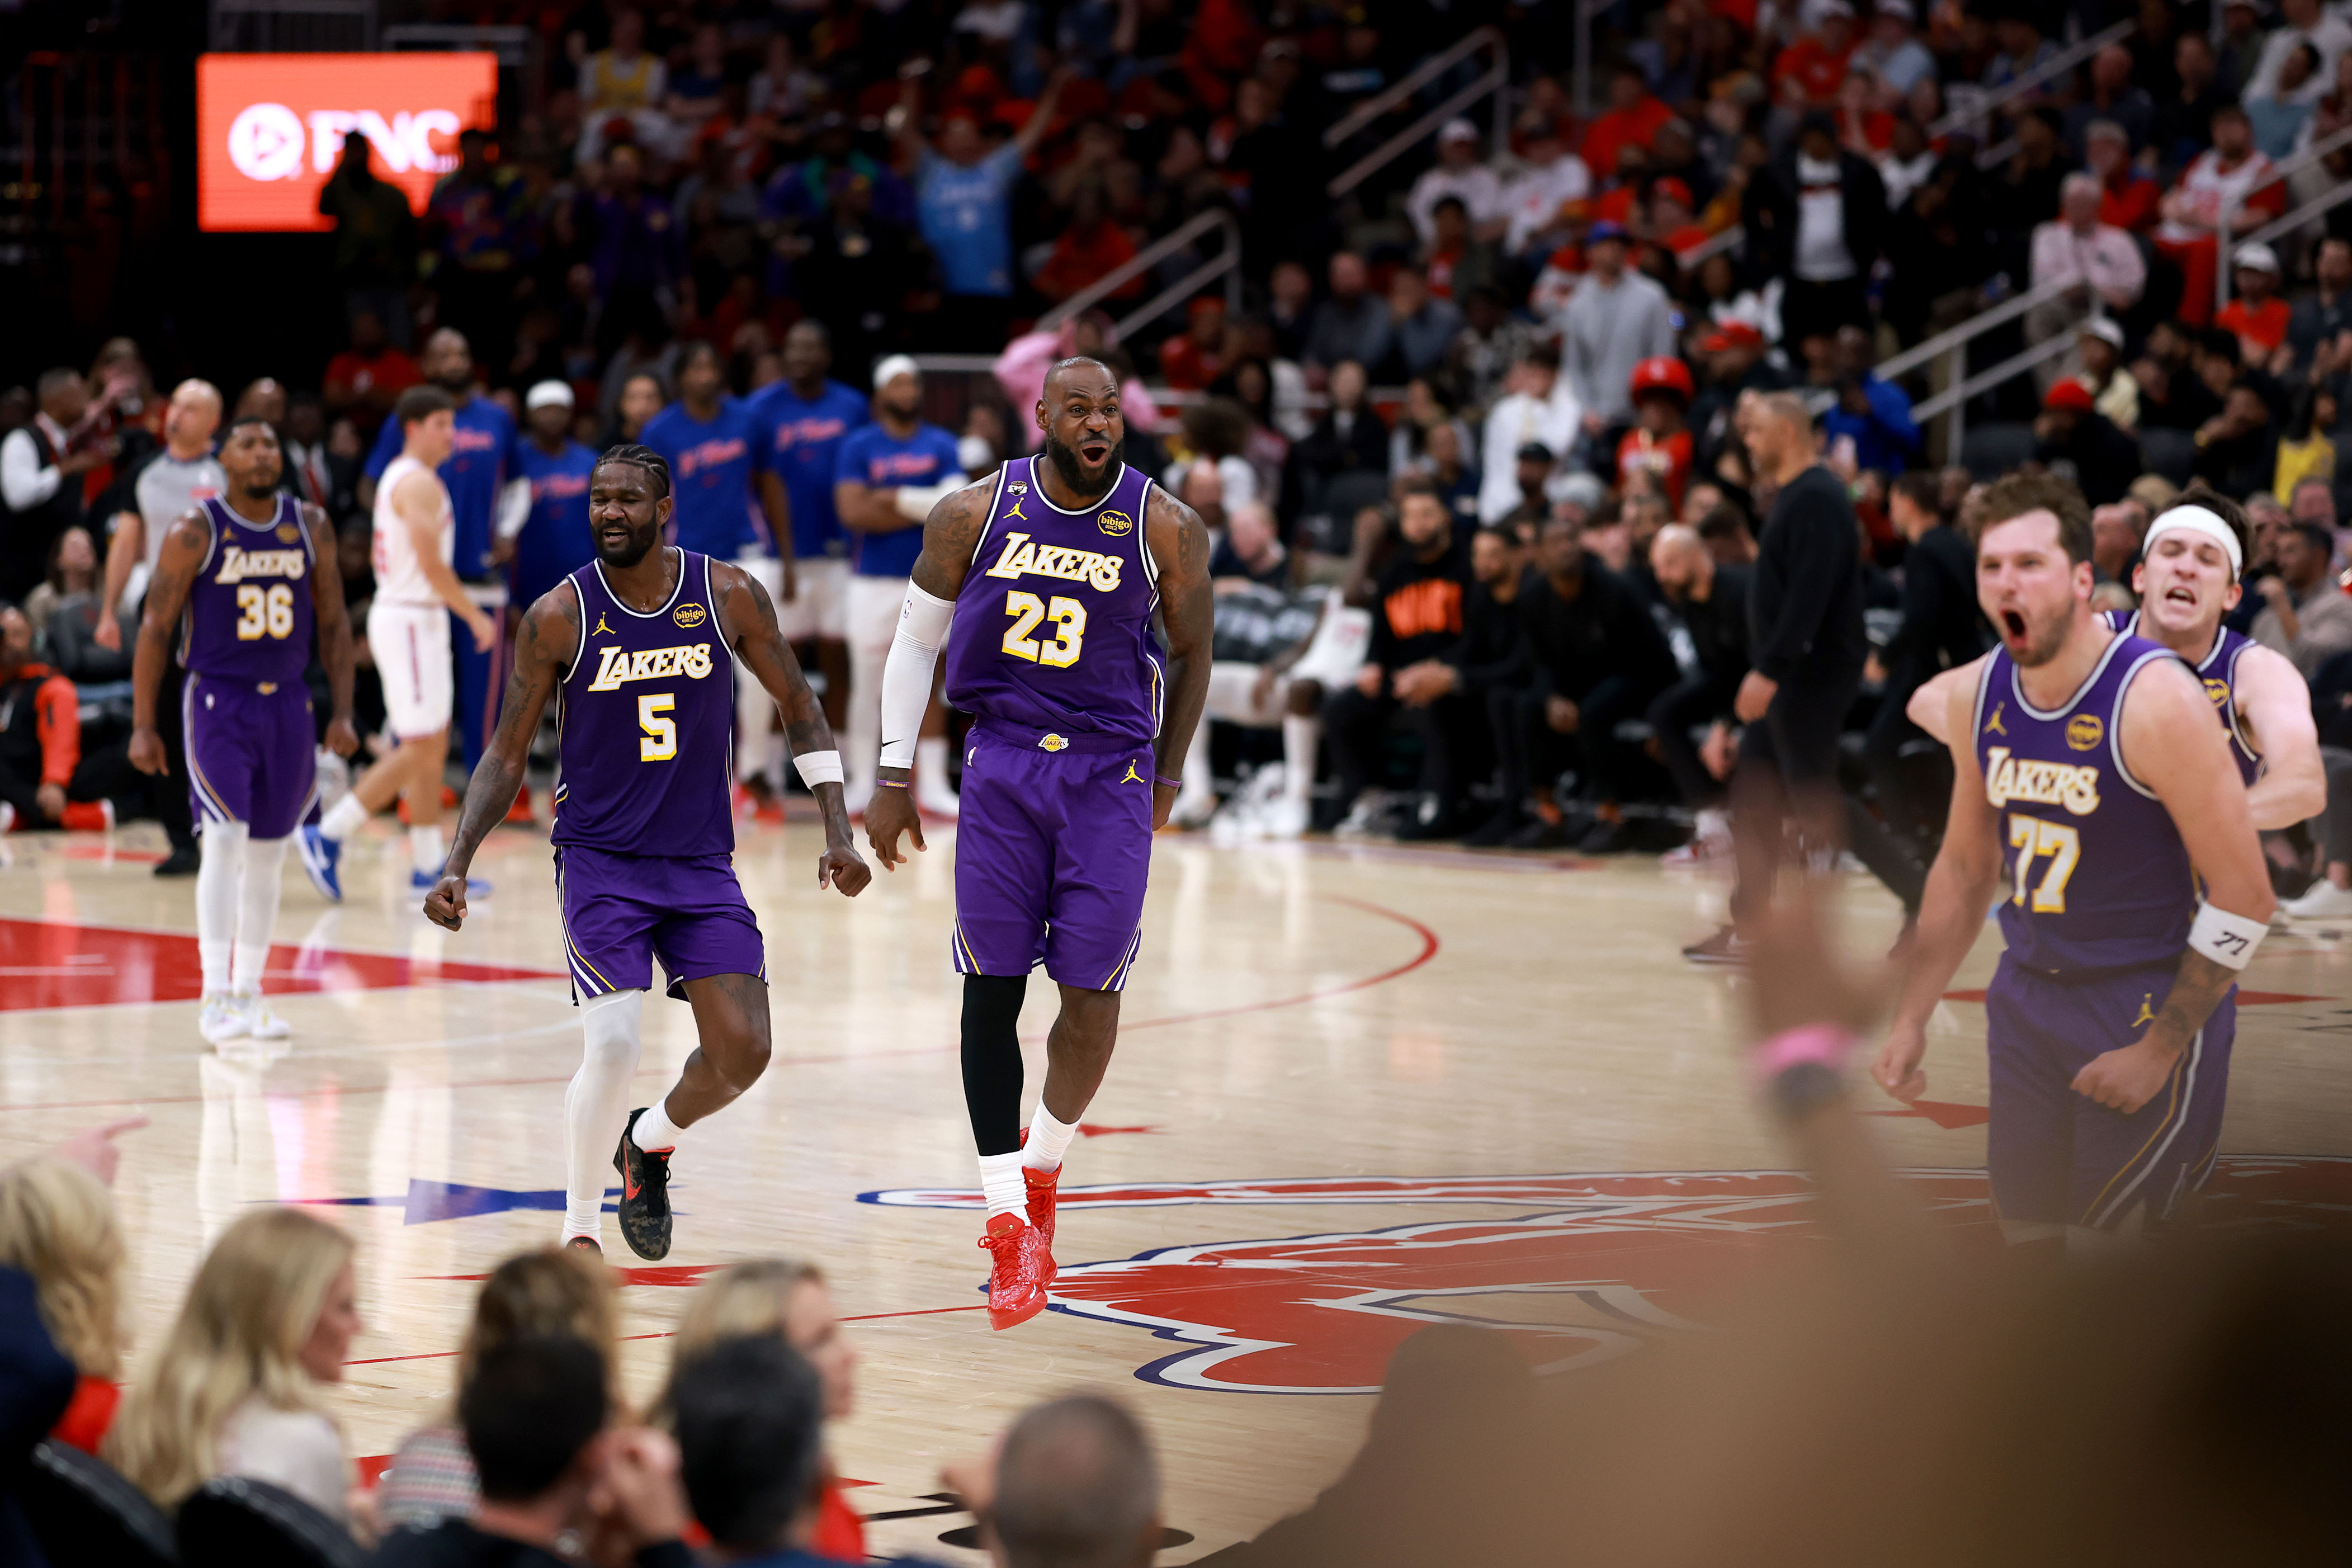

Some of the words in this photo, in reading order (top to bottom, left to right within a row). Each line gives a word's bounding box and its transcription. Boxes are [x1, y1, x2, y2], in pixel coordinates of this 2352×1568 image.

[308, 110, 459, 173] PNC
[1101, 516, 1130, 530] bibigo
[215, 546, 305, 584] LAKERS
[985, 532, 1124, 592] LAKERS
[237, 583, 294, 641] 36
[676, 610, 704, 620] bibigo
[1002, 590, 1087, 668] 23
[588, 643, 713, 692] LAKERS
[638, 693, 677, 762] 5
[1038, 736, 1069, 749] LAKERS
[1986, 745, 2101, 816] LAKERS
[2008, 813, 2081, 914] 77
[2213, 931, 2250, 956] 77
